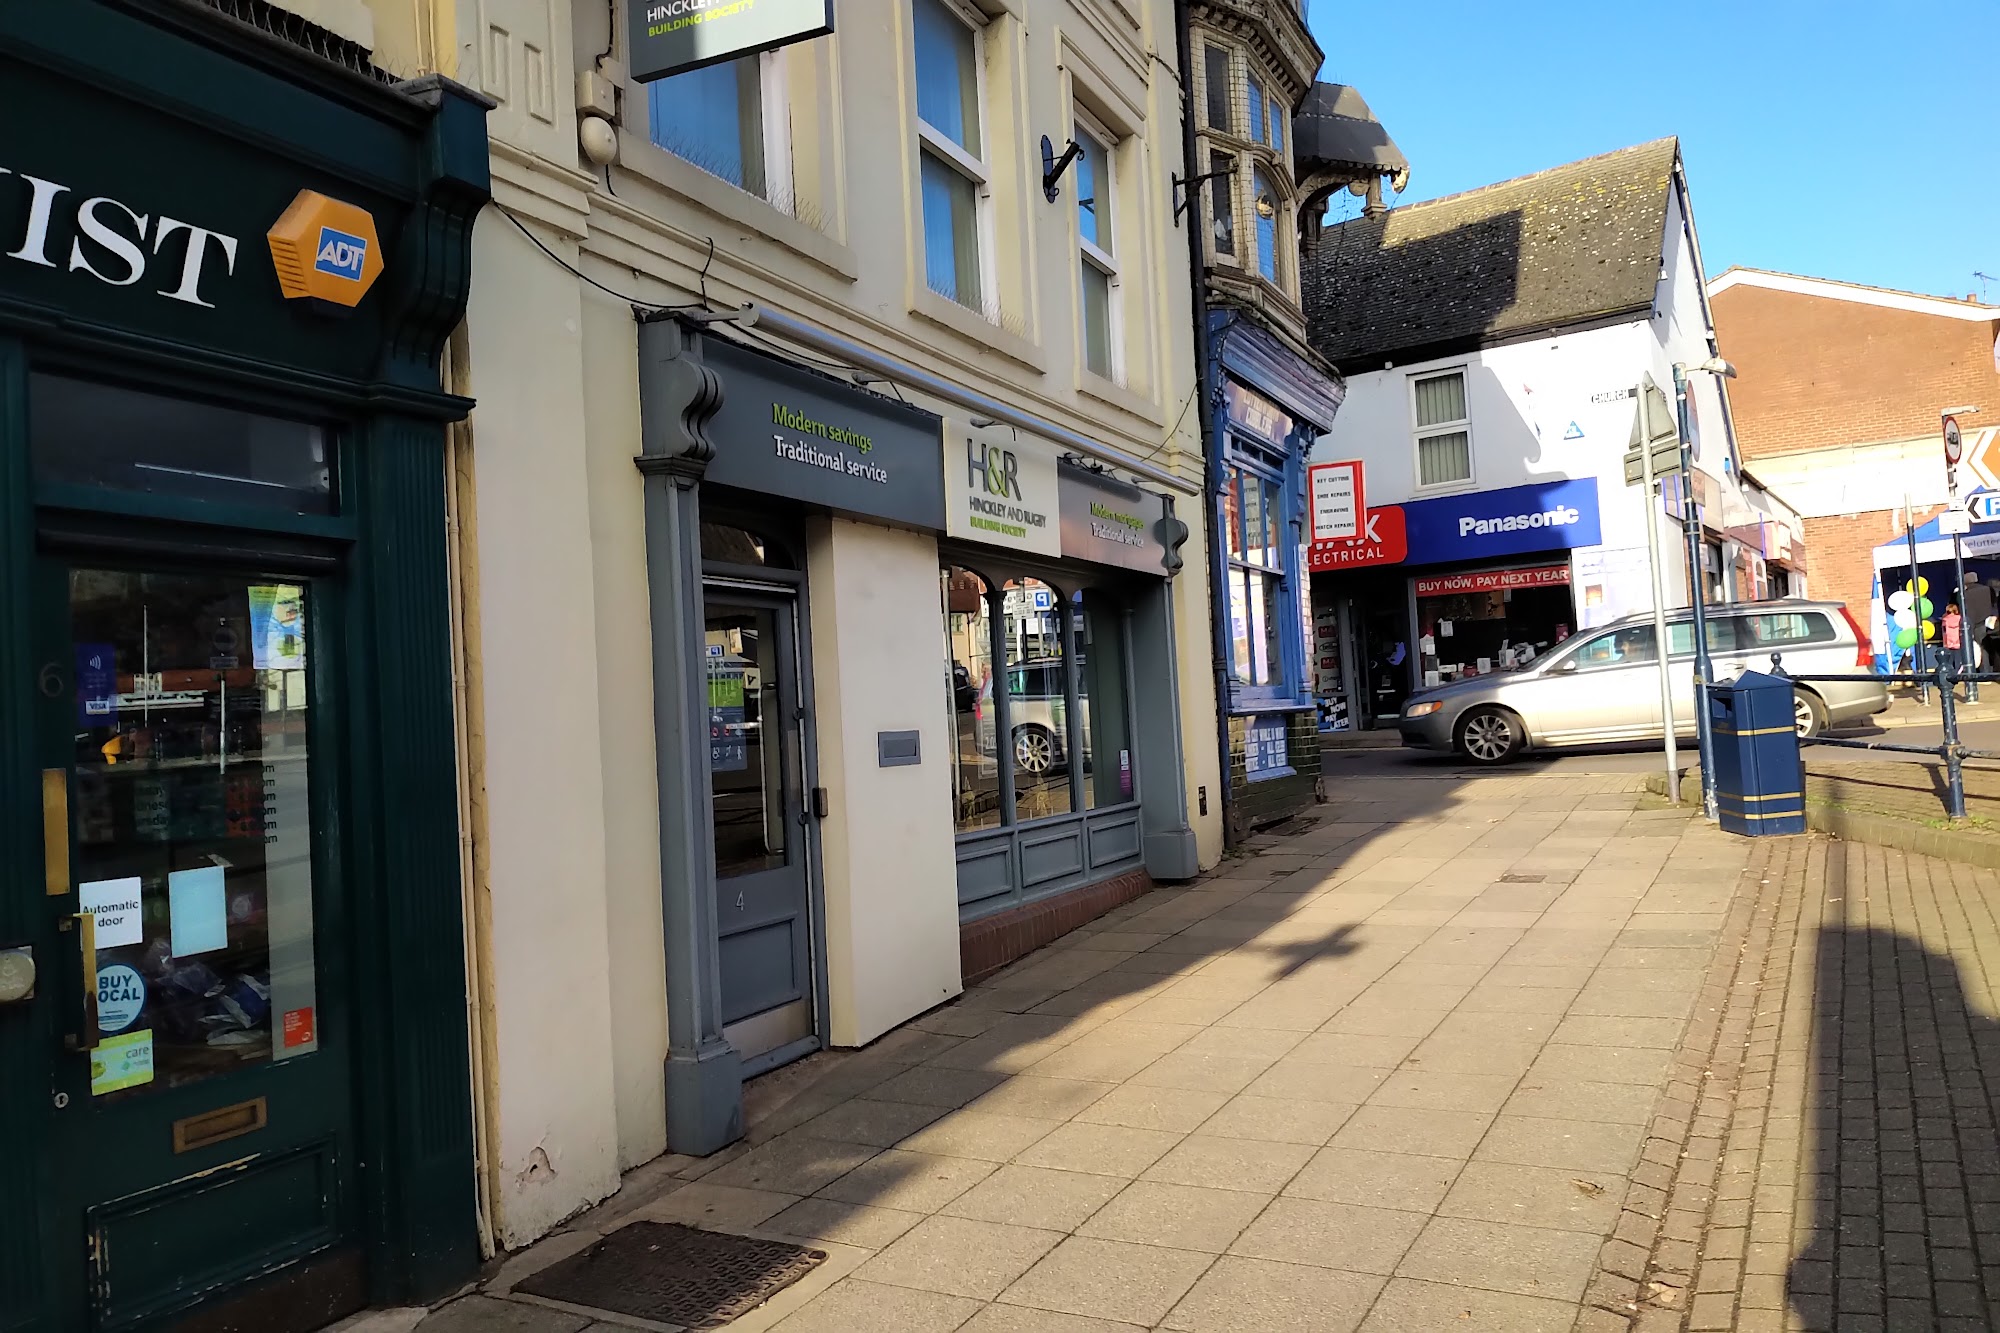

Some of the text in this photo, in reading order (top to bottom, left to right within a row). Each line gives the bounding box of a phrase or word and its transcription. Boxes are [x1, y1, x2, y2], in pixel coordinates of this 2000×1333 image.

[648, 0, 754, 37] BUILDING SOCIETY
[0, 167, 238, 308] IST
[316, 239, 366, 272] ADT
[772, 403, 873, 455] Modern savings
[773, 434, 888, 484] Traditional service
[966, 438, 1023, 501] H&R
[1328, 475, 1350, 483] CUTTING
[969, 495, 1047, 528] HINCKLEY AND RUGBY
[1459, 505, 1580, 537] Panasonic
[1090, 521, 1125, 544] Traditional
[1418, 577, 1442, 592] BUY
[1444, 576, 1474, 589] NOW,
[1476, 574, 1498, 587] PAY
[1500, 571, 1532, 585] NEXT
[40, 662, 64, 698] 6
[1324, 697, 1337, 707] BUY
[1330, 702, 1346, 713] NOW
[1325, 713, 1337, 723] PAY
[1330, 717, 1349, 730] LATER
[82, 899, 140, 914] Automatic
[736, 890, 745, 911] 4
[97, 914, 124, 928] door
[98, 974, 133, 990] BUY
[97, 987, 141, 1004] OCAL
[125, 1045, 150, 1060] care
